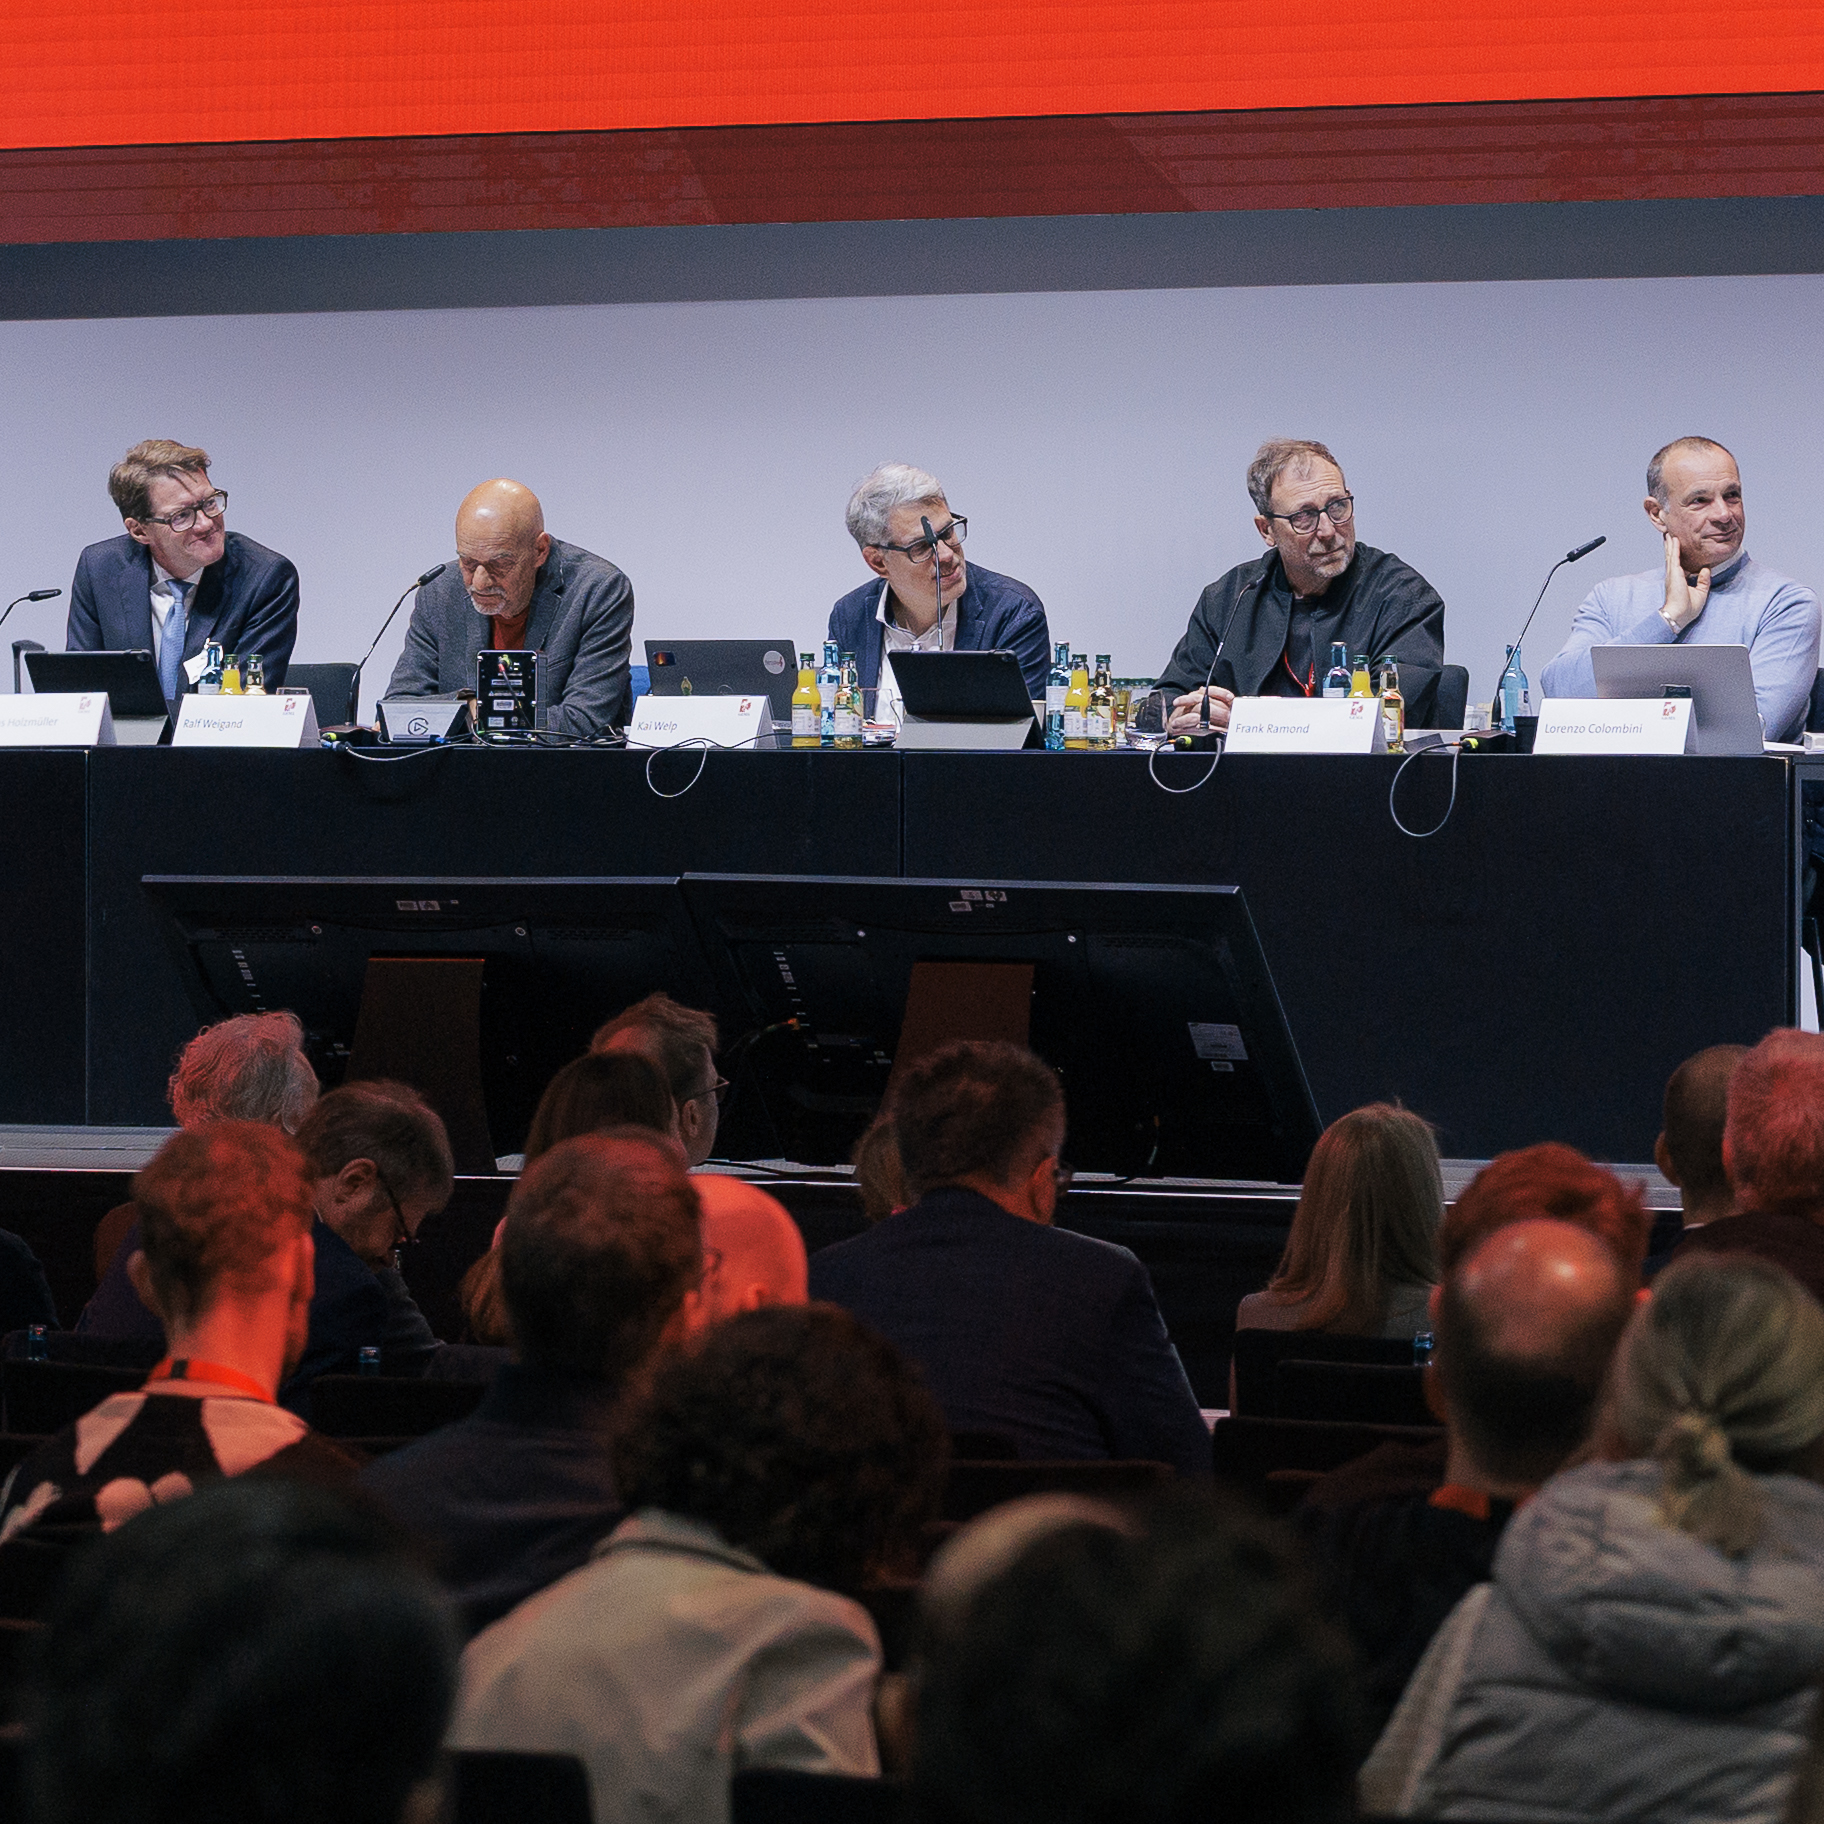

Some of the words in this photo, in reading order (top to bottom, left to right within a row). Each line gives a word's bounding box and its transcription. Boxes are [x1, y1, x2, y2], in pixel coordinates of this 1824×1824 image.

[6, 716, 59, 727] Holzmüller
[182, 718, 202, 729] Ralf
[202, 718, 244, 731] Weigand
[636, 721, 653, 732] Kai
[654, 720, 678, 734] Welp
[1235, 723, 1266, 734] Frank
[1266, 723, 1310, 734] Ramond
[1544, 722, 1586, 734] Lorenzo
[1587, 722, 1643, 734] Colombini
